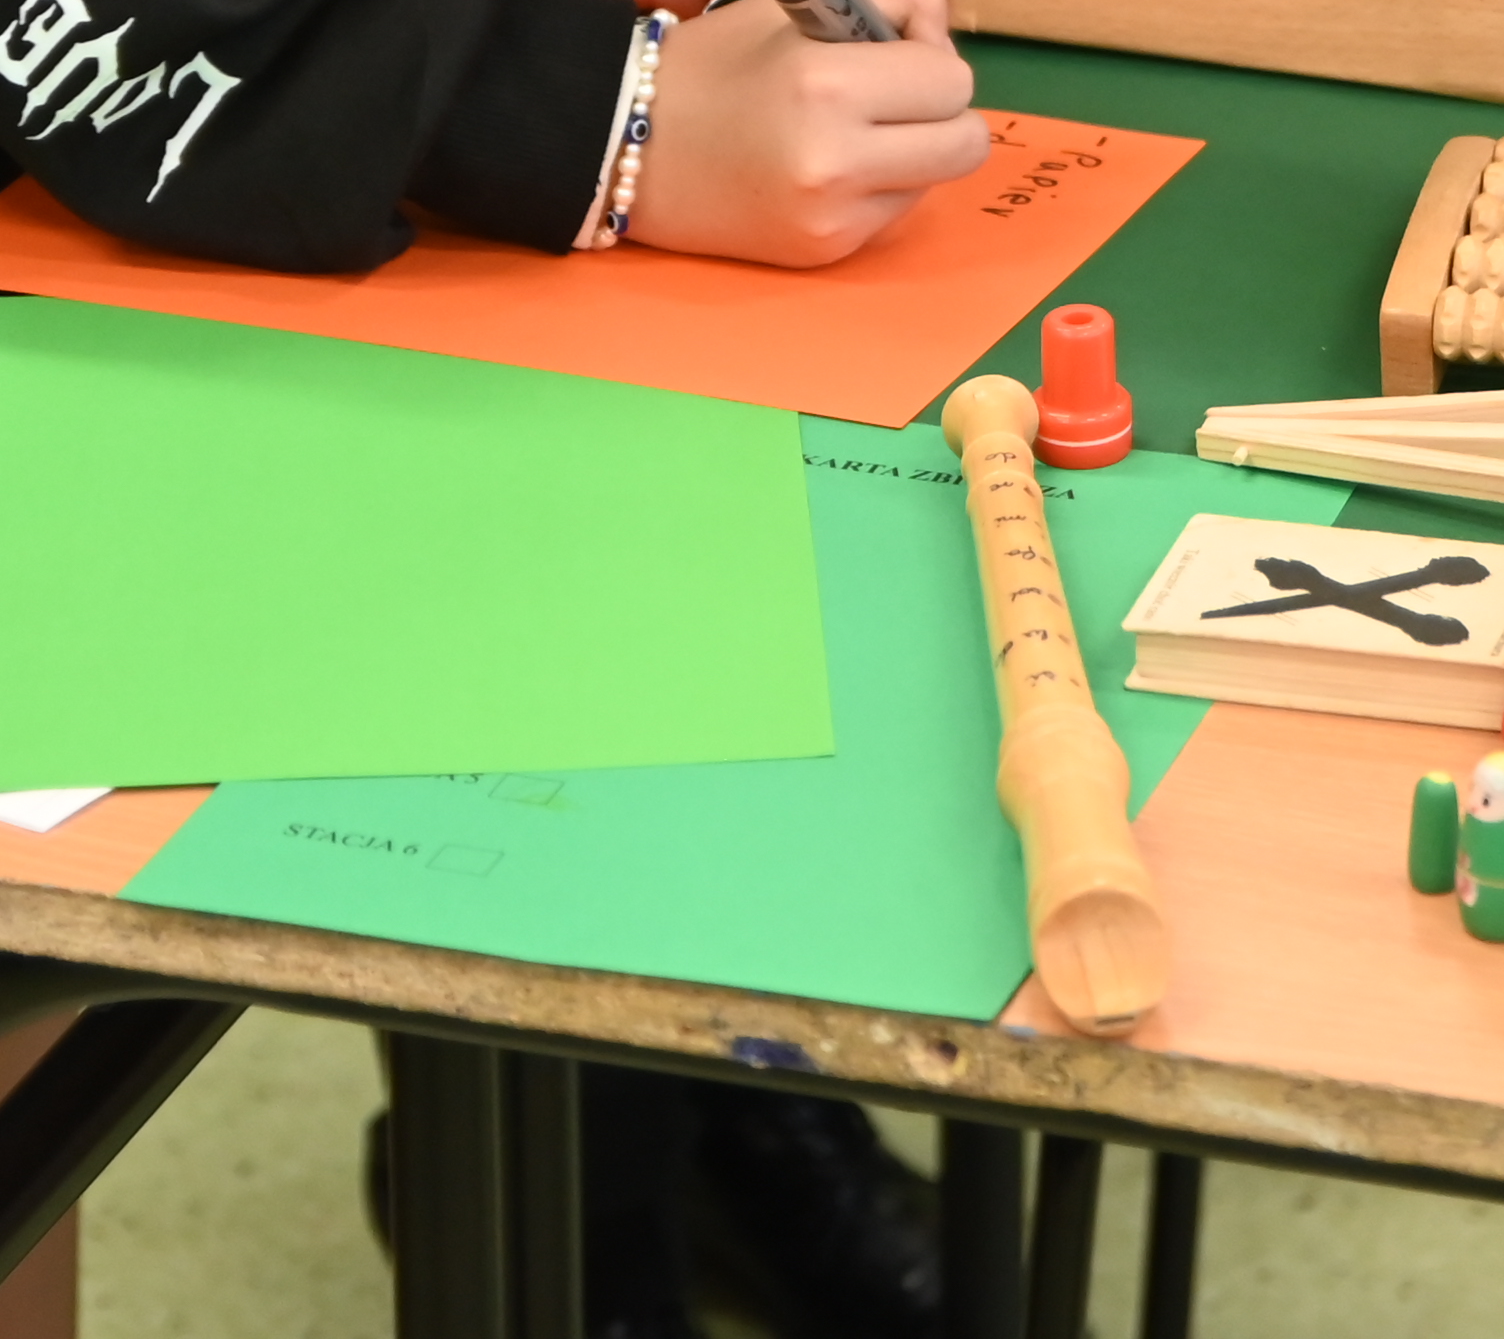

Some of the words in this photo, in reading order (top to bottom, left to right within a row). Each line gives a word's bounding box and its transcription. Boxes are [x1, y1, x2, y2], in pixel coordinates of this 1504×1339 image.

[802, 453, 900, 478] KARTA
[283, 823, 393, 853] STACJA
[402, 843, 420, 856] 6
